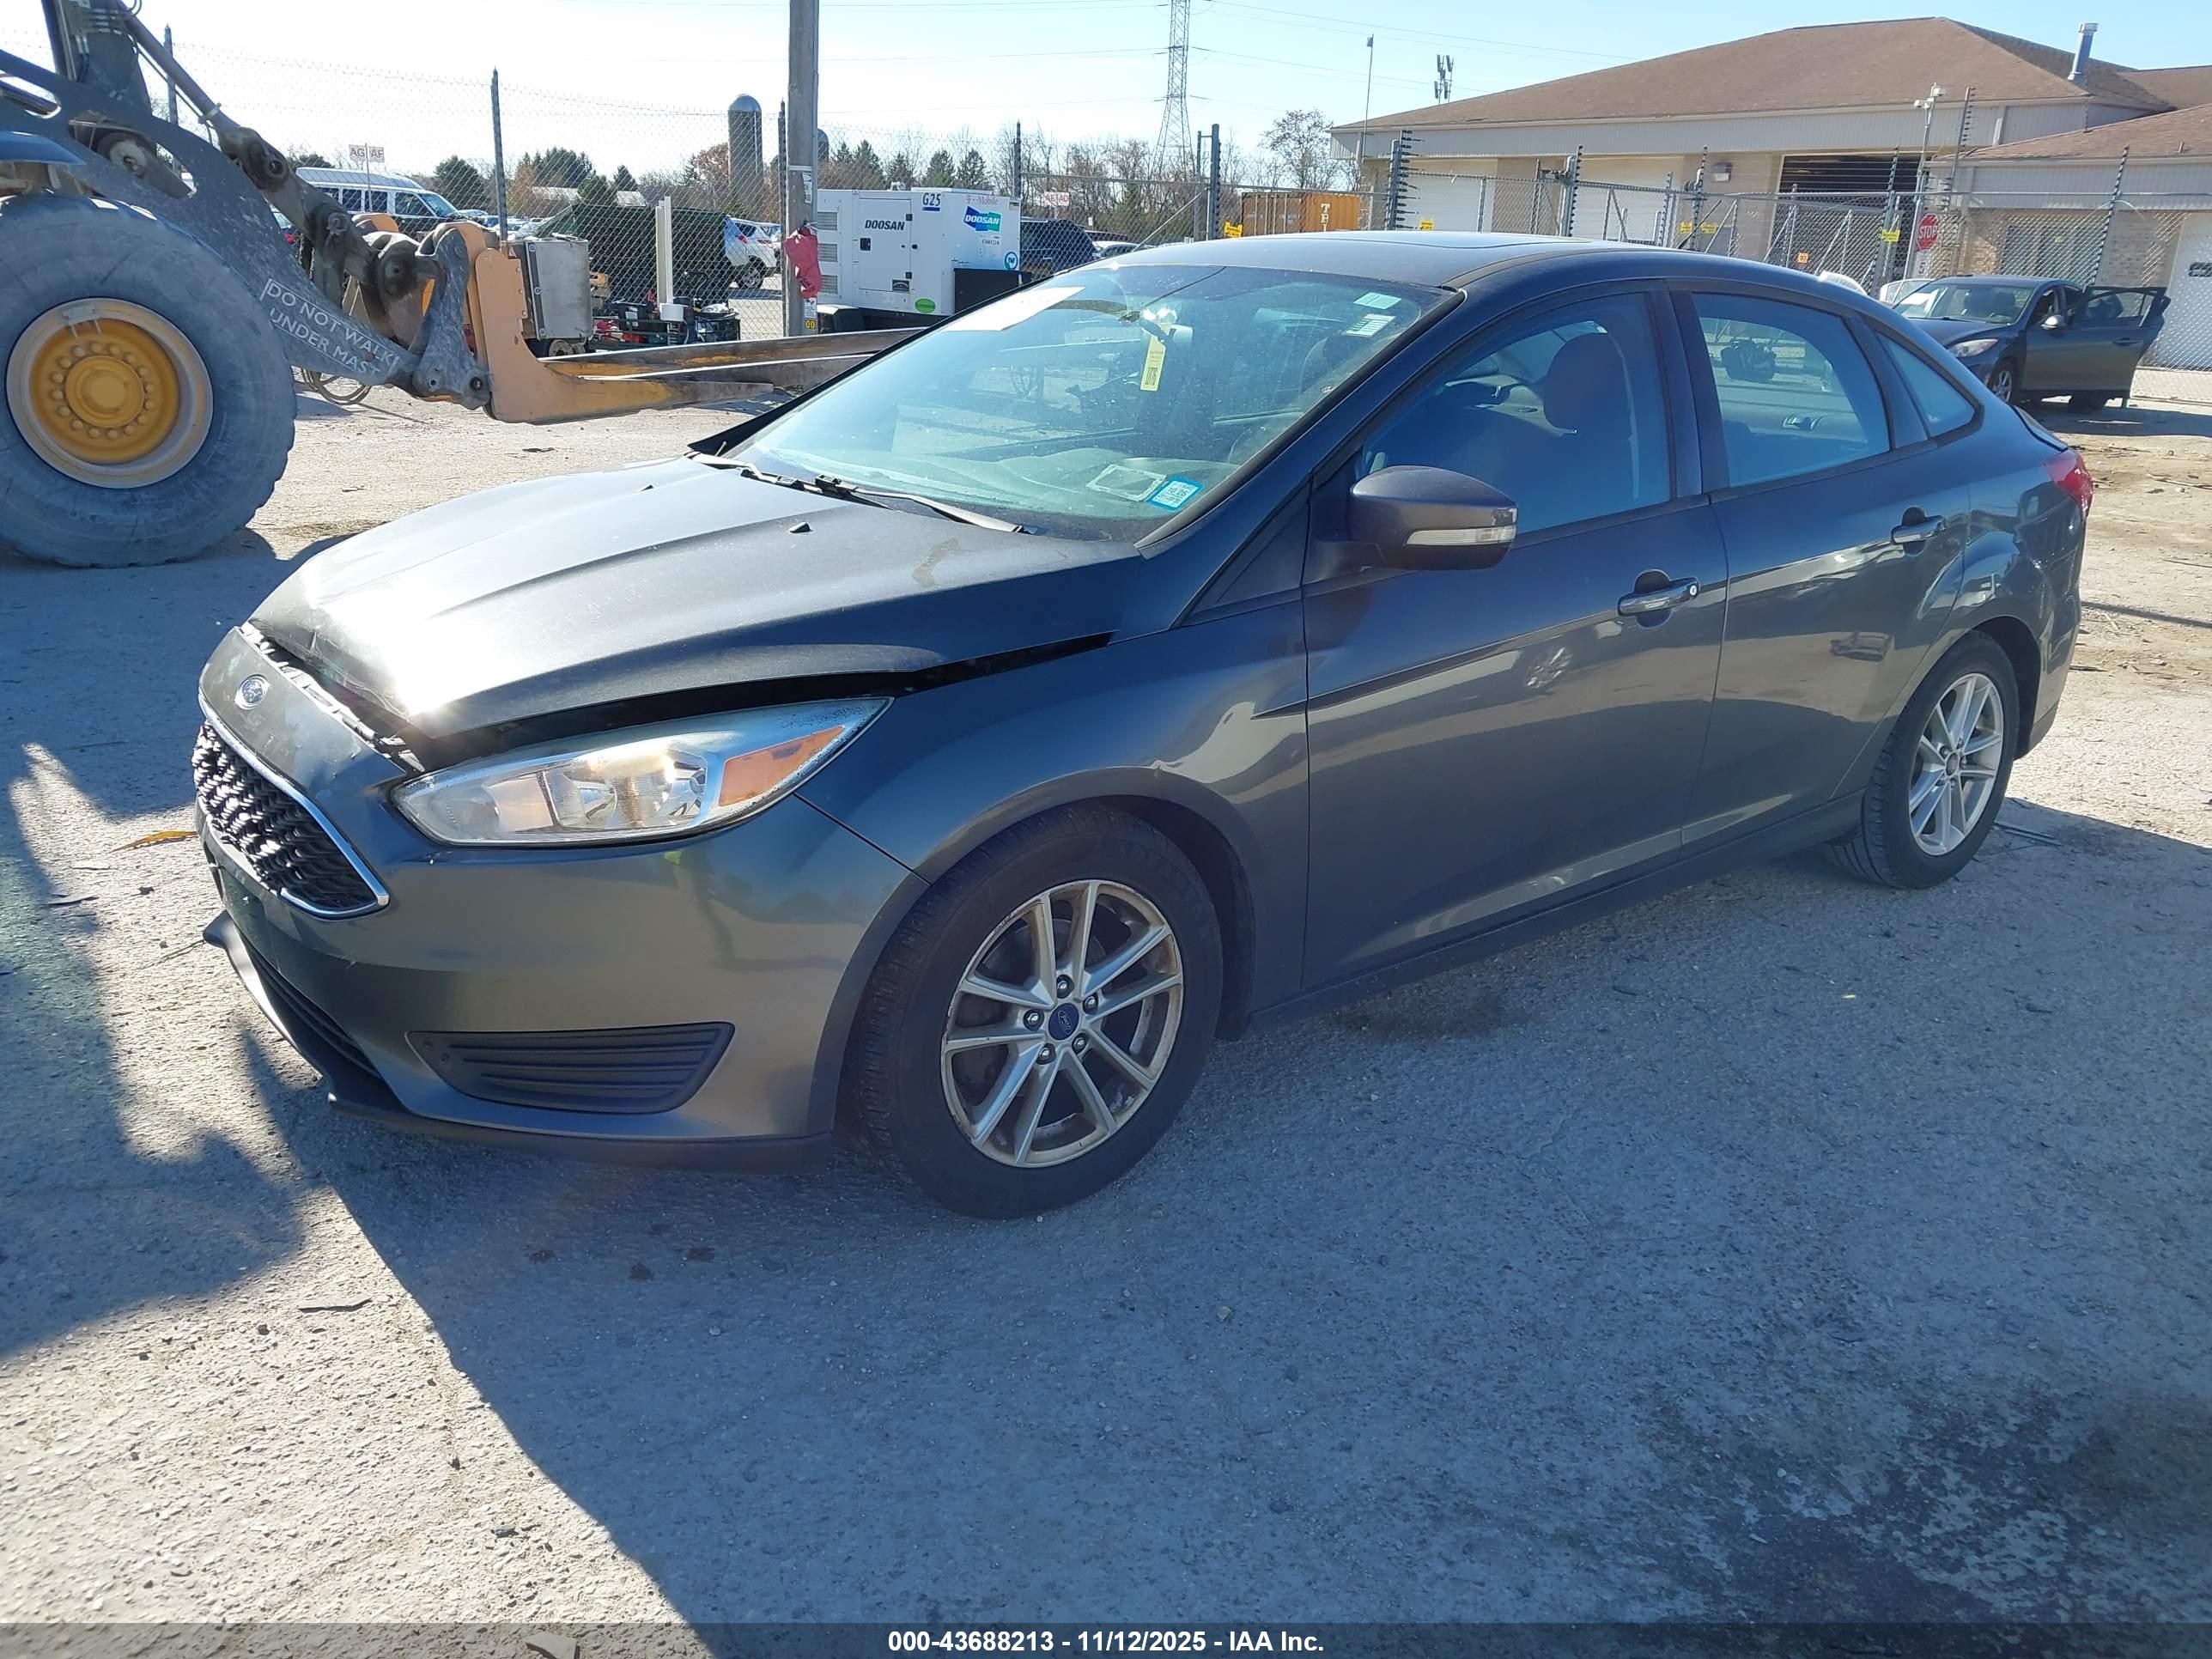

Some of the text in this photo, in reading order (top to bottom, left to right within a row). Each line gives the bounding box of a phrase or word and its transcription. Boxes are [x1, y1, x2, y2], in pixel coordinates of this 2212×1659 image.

[922, 192, 941, 207] G25
[865, 220, 905, 231] DOOSAN
[964, 215, 1000, 224] DOOSAN
[1918, 225, 1937, 240] STOP
[266, 283, 394, 366] DO NOT WALK
[270, 307, 381, 375] UNDER MAST
